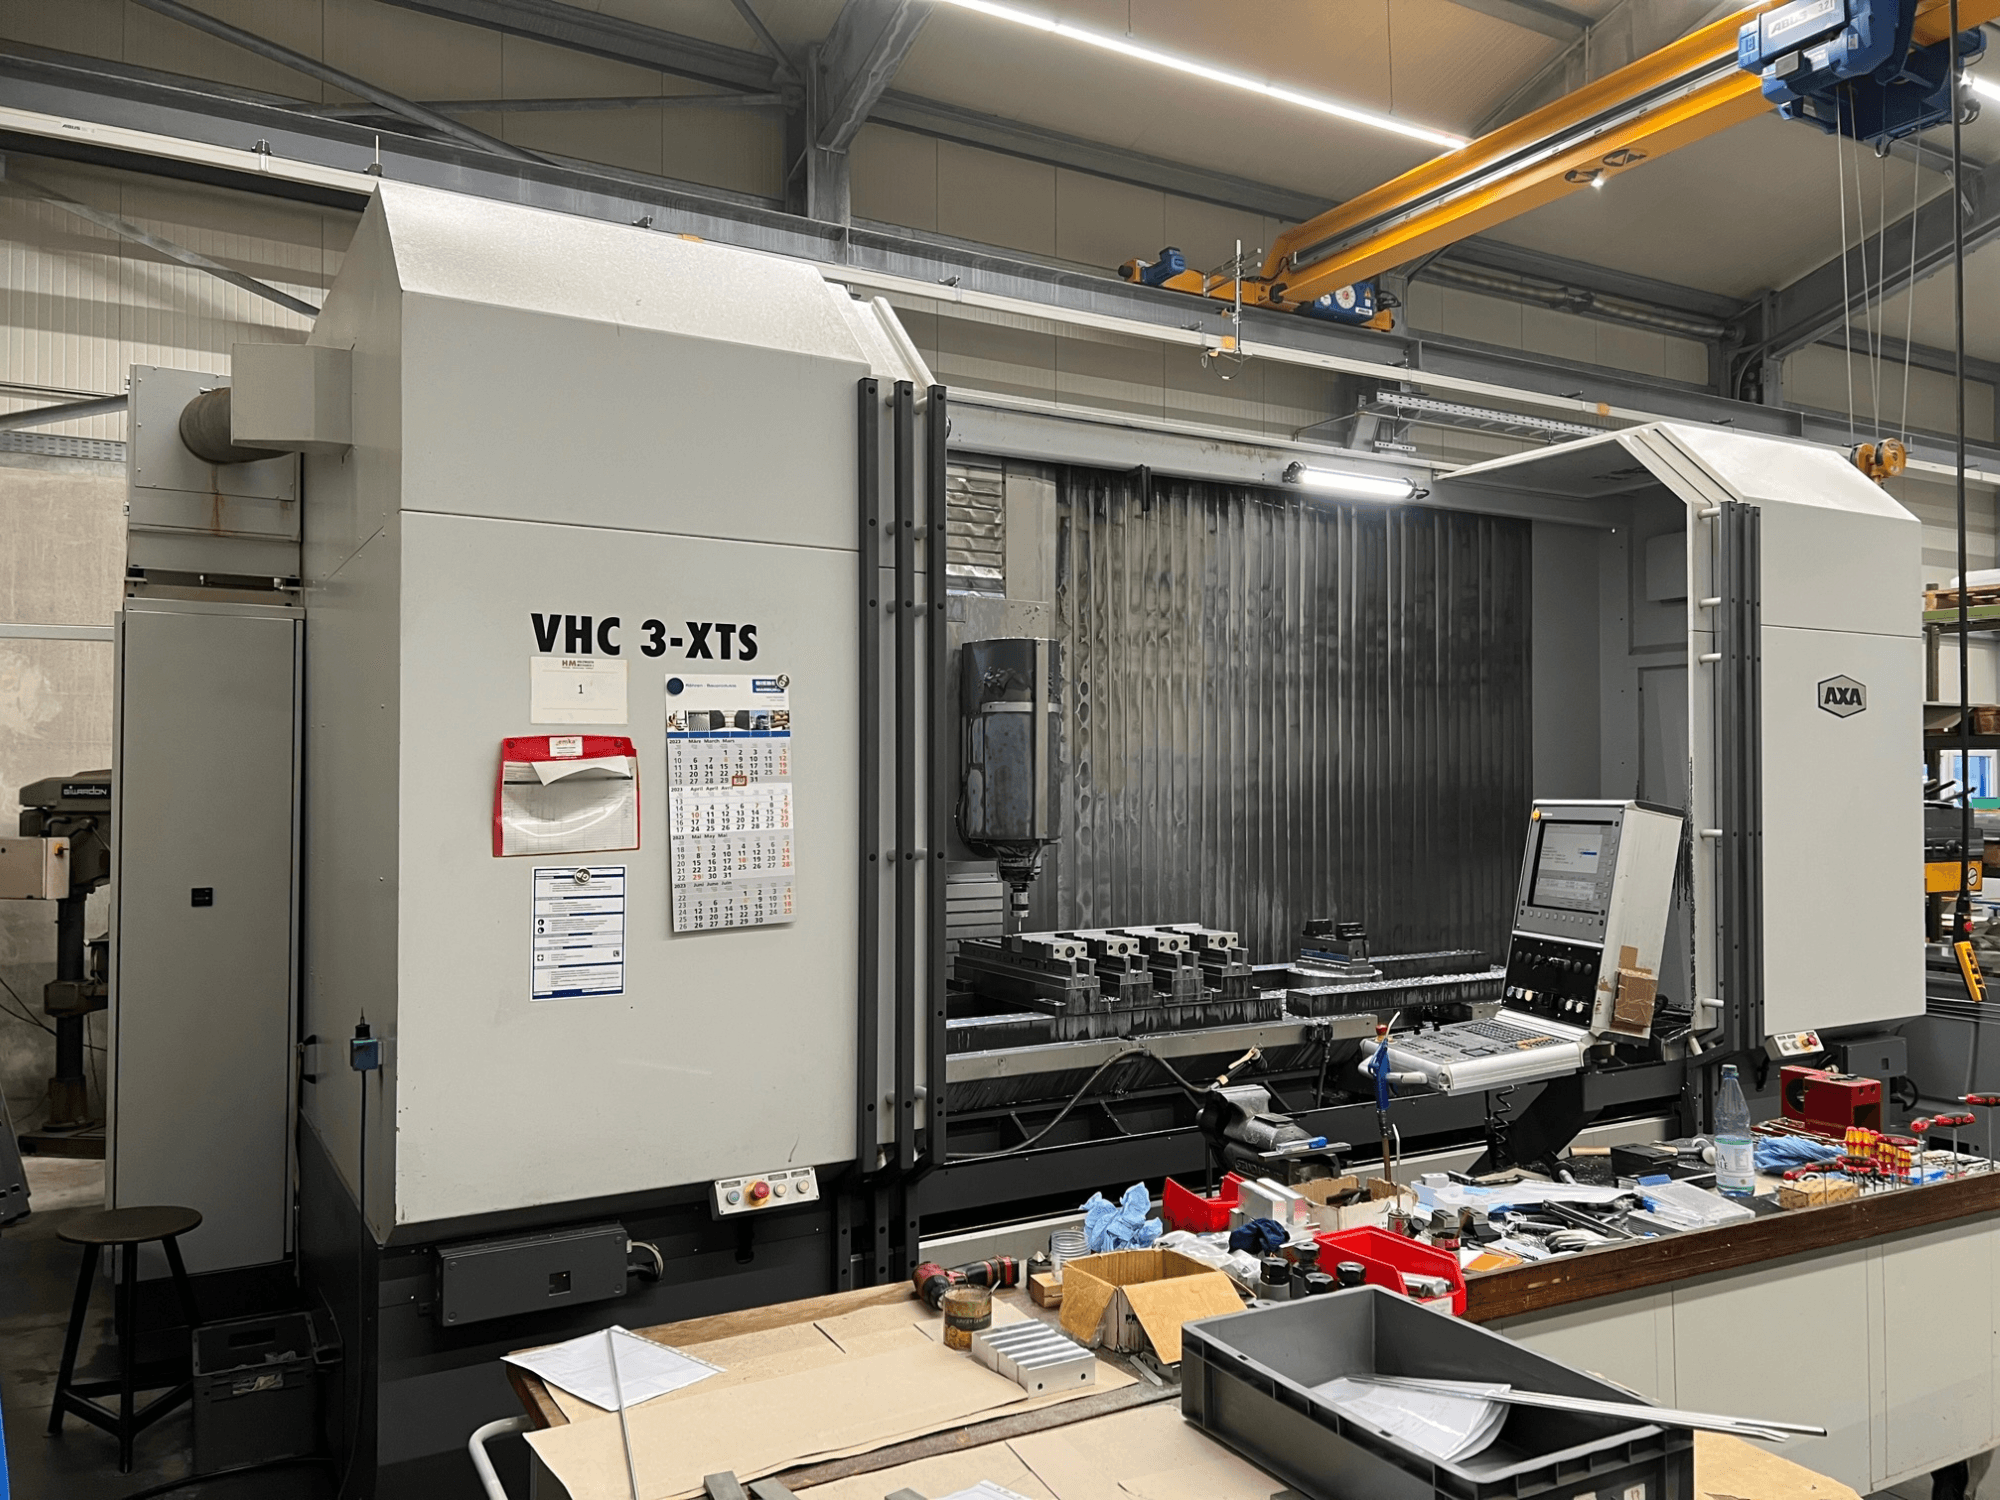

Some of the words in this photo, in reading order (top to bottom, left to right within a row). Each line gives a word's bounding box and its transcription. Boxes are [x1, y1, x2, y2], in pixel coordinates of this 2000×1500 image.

[1771, 10, 1807, 35] ABUS
[530, 613, 621, 656] VHC
[640, 618, 758, 661] 3-XTS
[578, 684, 583, 694] 1
[1824, 687, 1862, 706] AXA
